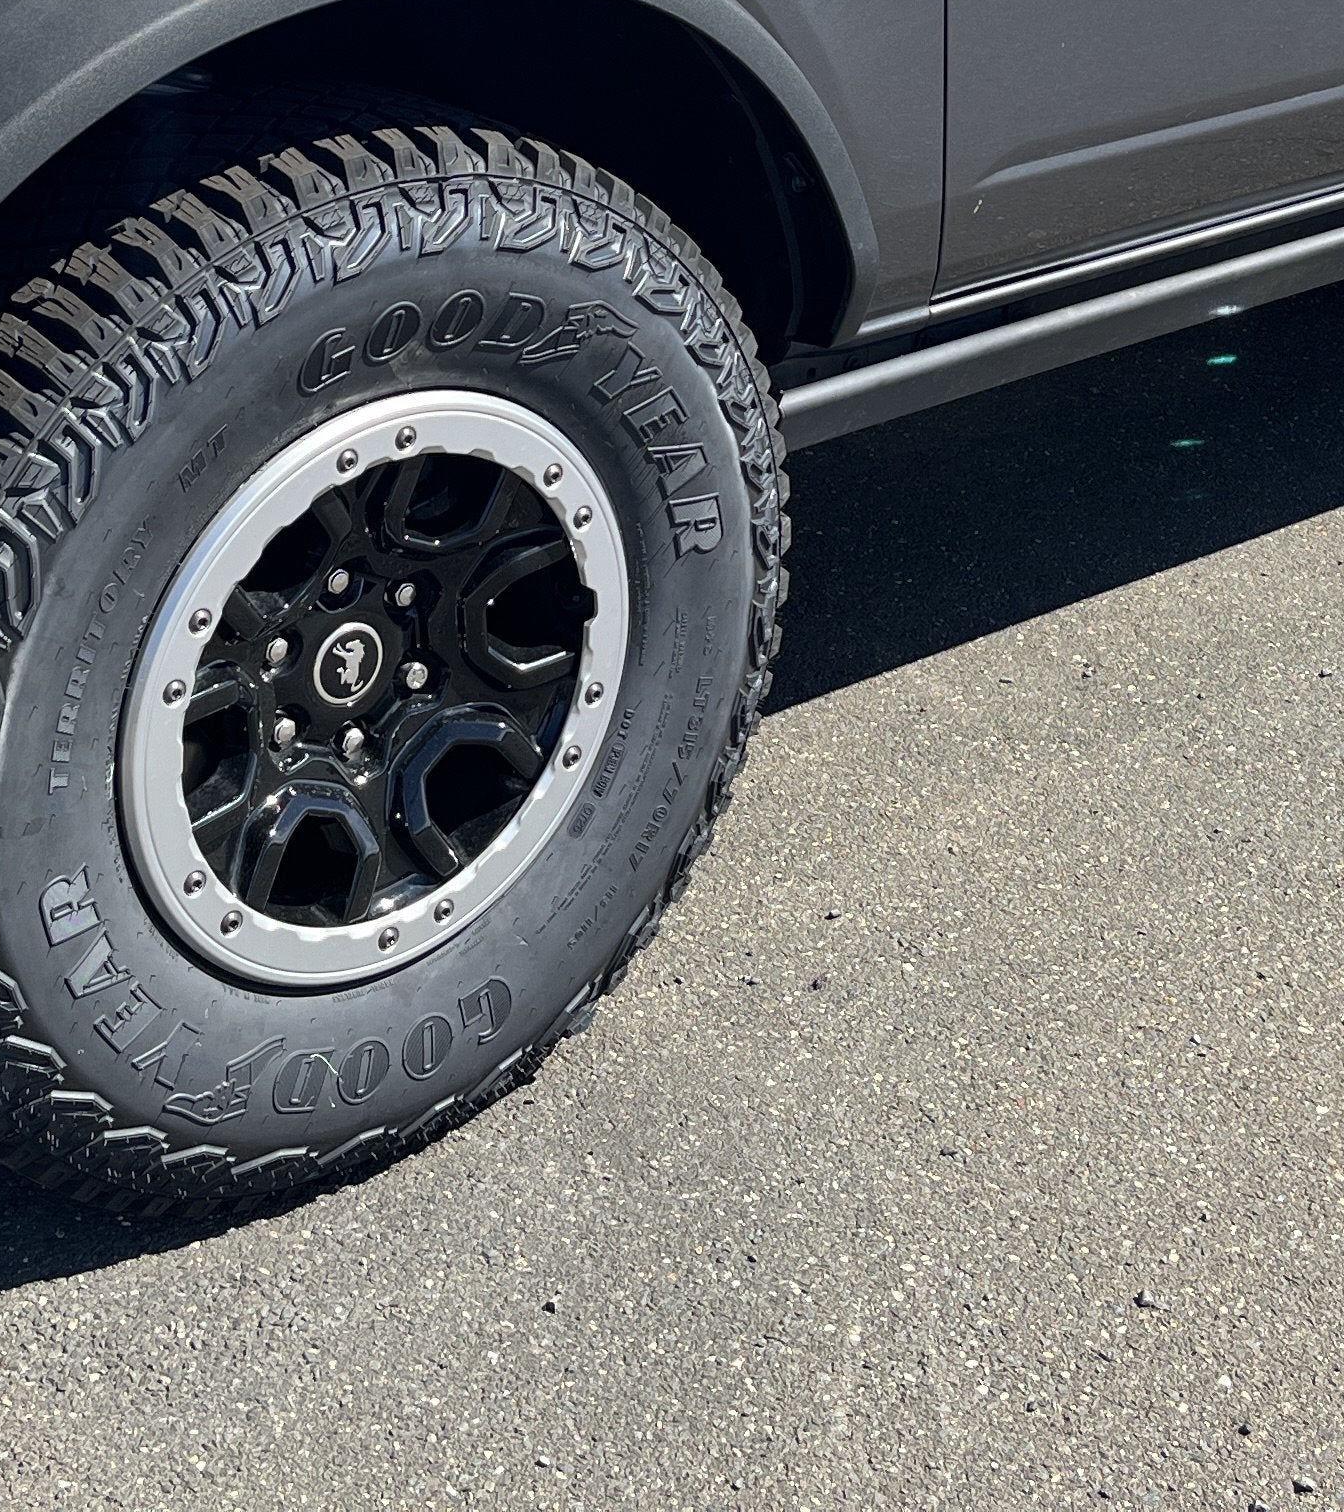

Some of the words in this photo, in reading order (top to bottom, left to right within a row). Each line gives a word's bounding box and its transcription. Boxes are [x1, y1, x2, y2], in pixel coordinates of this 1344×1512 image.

[296, 288, 727, 561] GOODYEAR
[47, 513, 156, 796] TERRITORY
[176, 423, 229, 494] MT
[615, 707, 637, 741] DOT
[38, 860, 515, 1127] GOODYEAR
